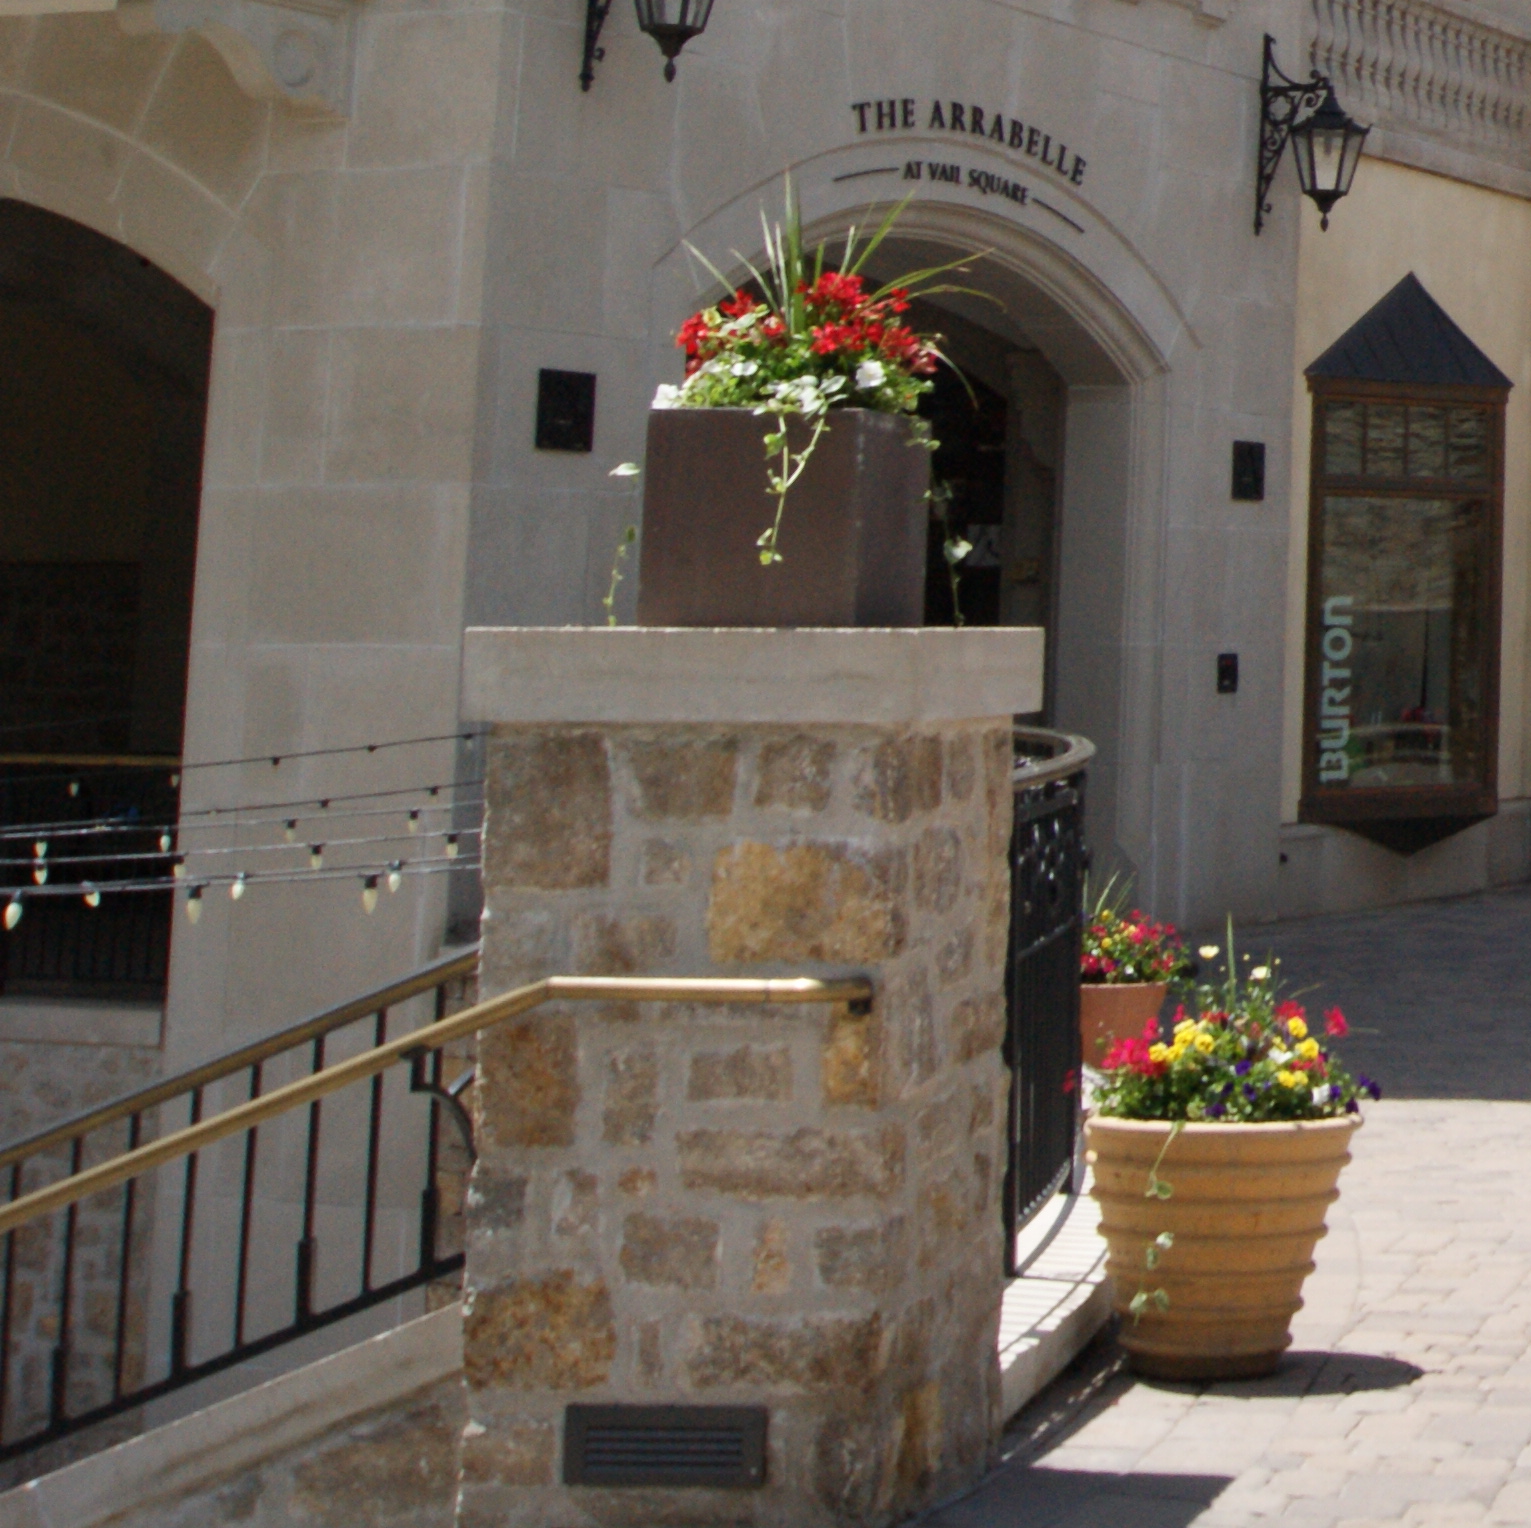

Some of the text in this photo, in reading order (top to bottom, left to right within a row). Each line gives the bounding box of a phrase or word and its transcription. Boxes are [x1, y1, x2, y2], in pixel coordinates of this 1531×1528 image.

[852, 99, 1087, 186] THE ARRABELLE
[903, 160, 1030, 205] AT VAIL SQUARE
[1319, 594, 1354, 784] BURTON
